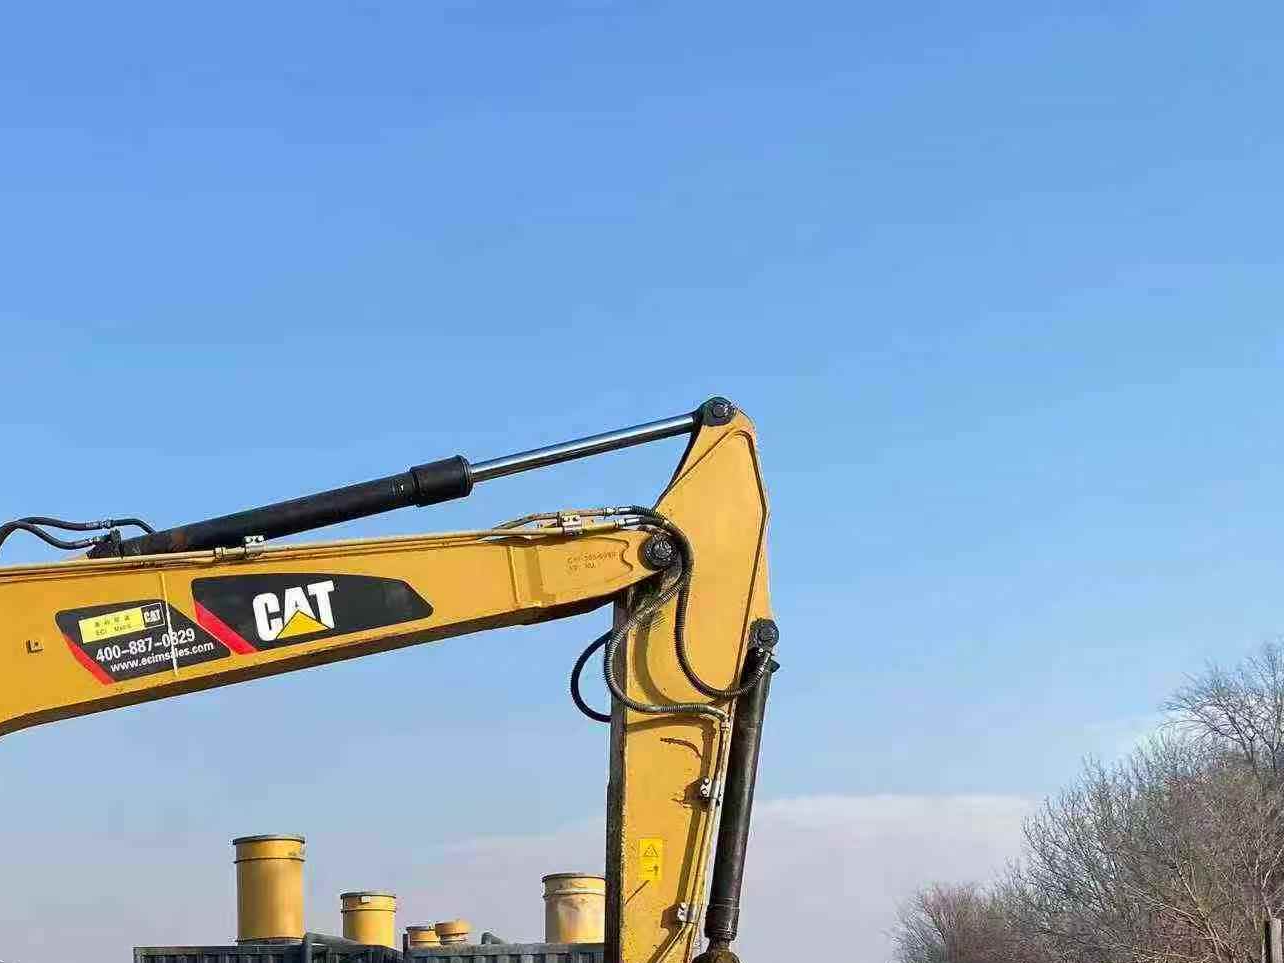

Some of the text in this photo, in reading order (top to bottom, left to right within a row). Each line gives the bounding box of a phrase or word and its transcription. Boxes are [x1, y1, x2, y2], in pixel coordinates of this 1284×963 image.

[144, 609, 161, 623] CAT
[253, 580, 334, 641] CAT
[96, 628, 195, 663] 400-887-0829
[110, 641, 214, 672] www.ecimsales.com
